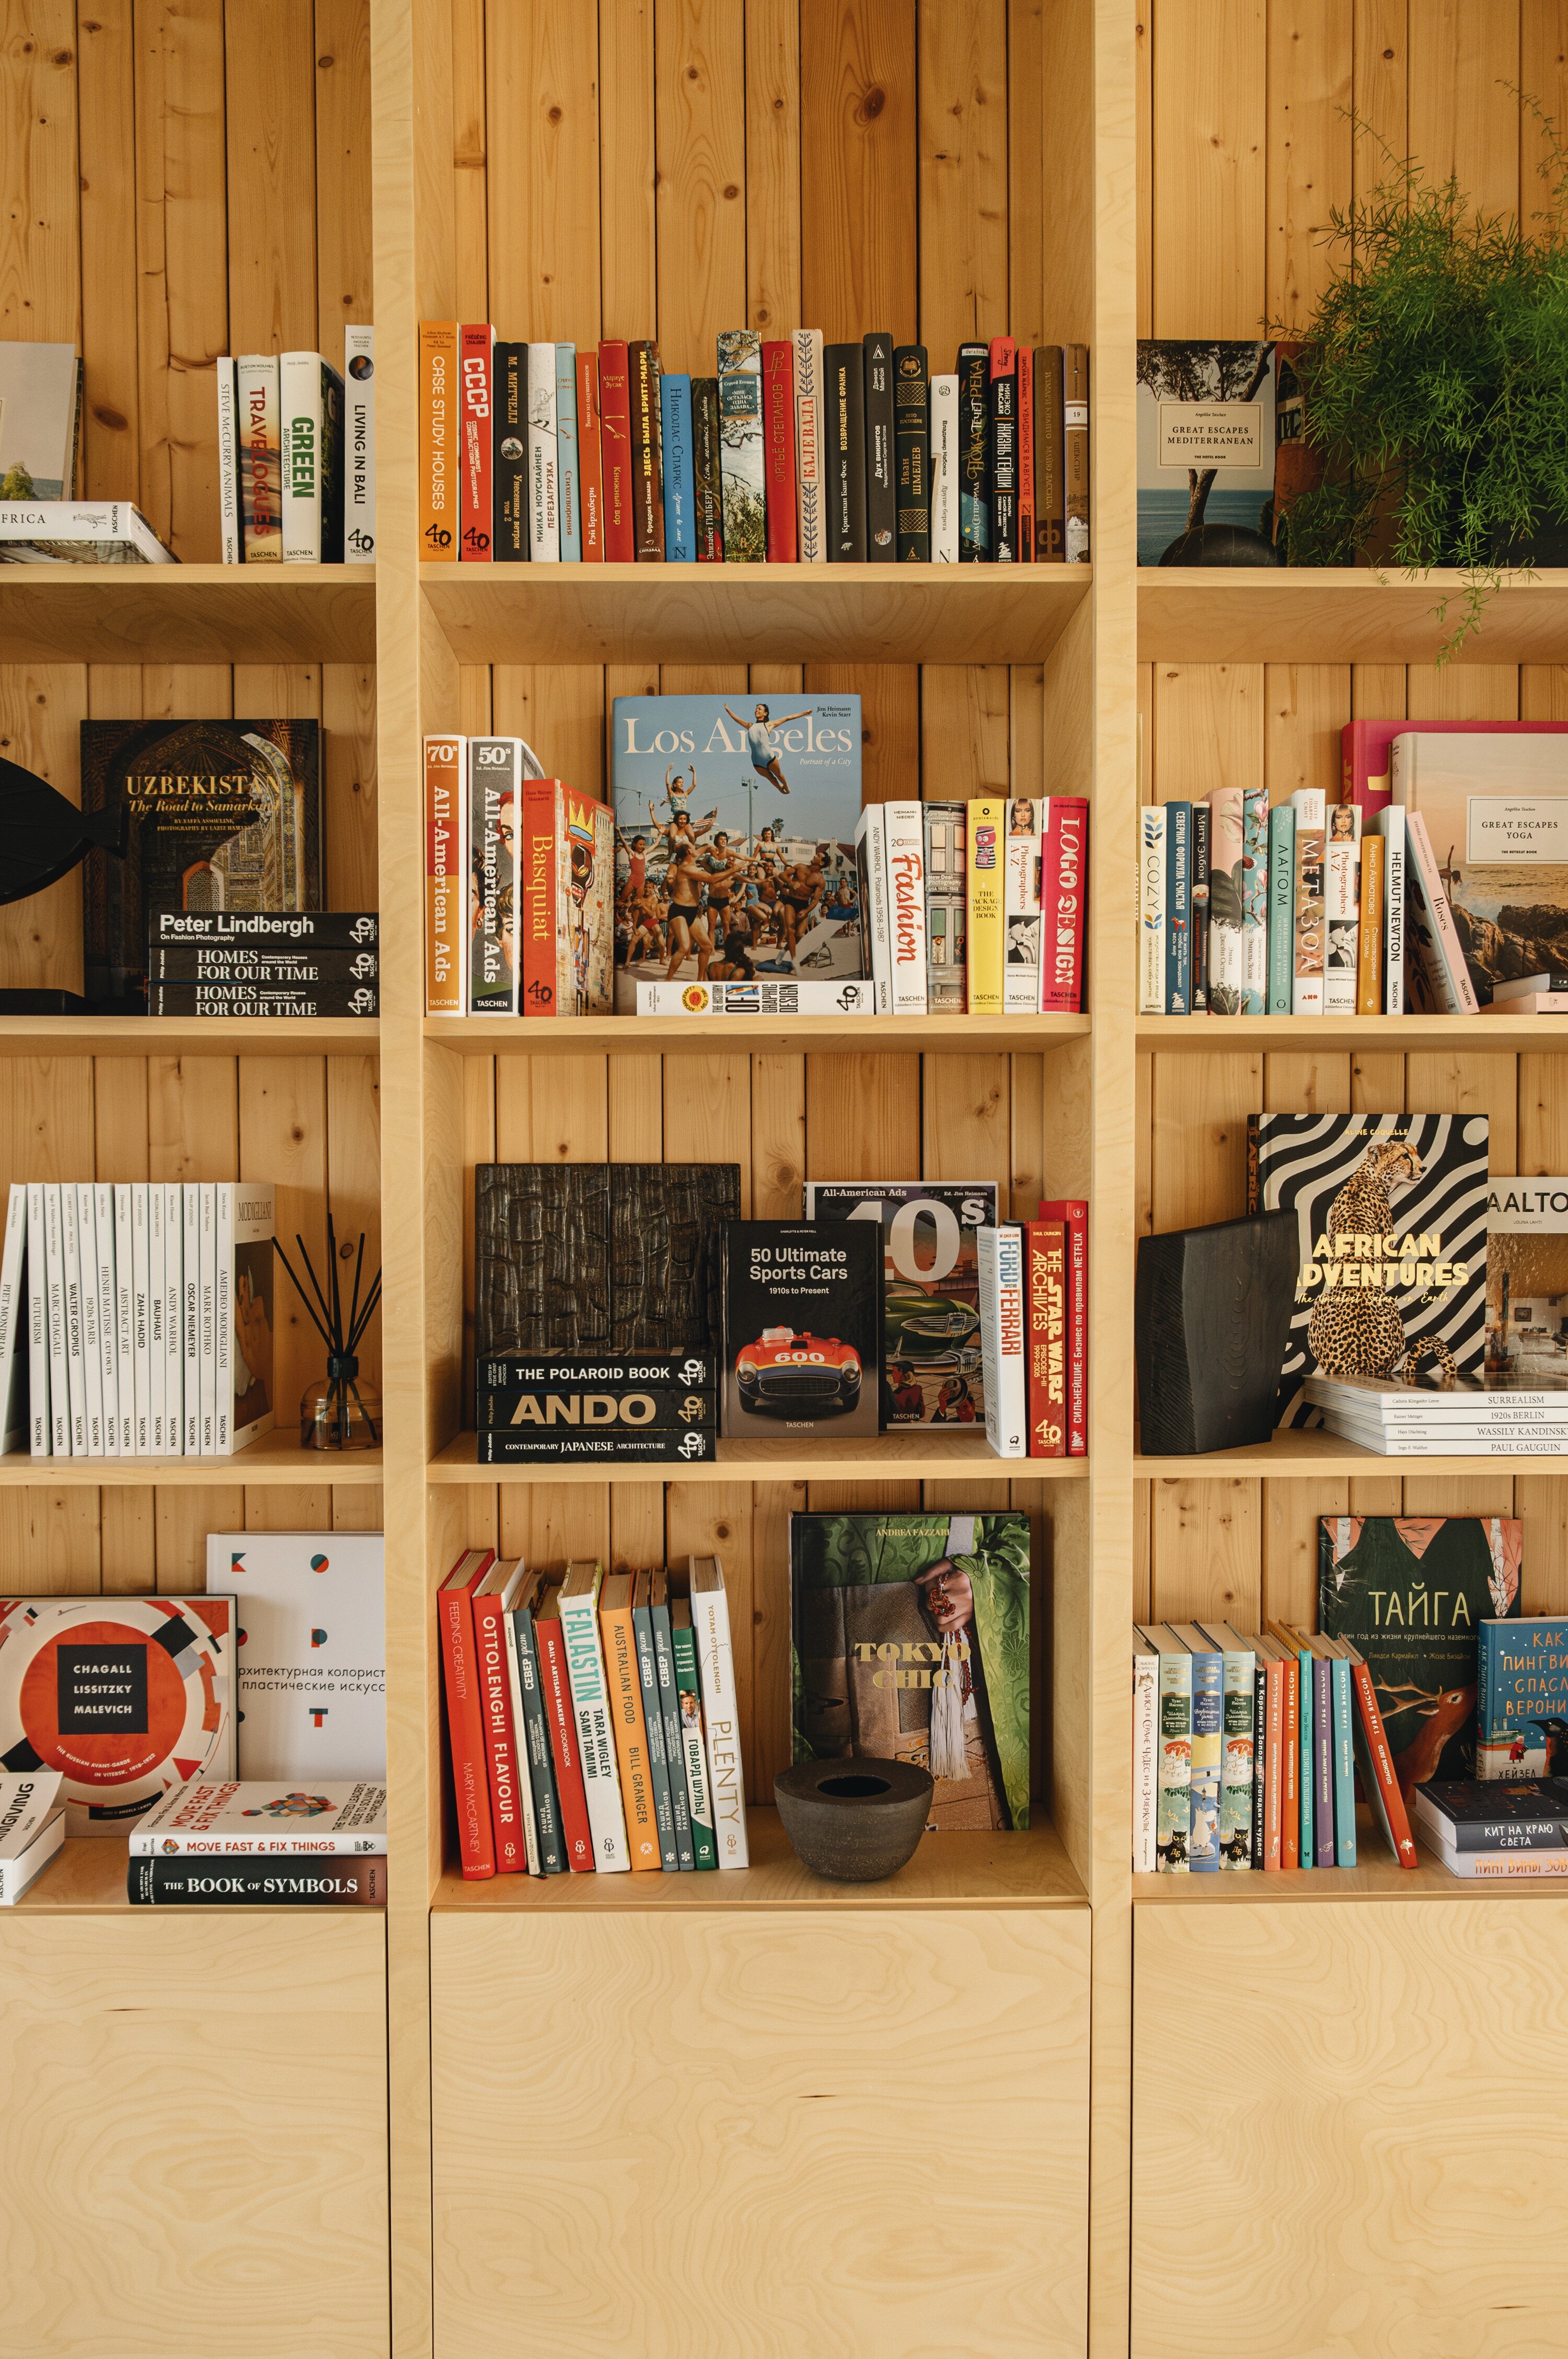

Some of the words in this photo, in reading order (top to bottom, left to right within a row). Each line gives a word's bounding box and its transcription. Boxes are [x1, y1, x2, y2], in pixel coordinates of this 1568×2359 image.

[433, 356, 445, 395] CASE
[640, 351, 649, 413] БРИТТ-МАРИ
[221, 384, 229, 412] STEVE
[355, 406, 365, 451] LIVING
[433, 399, 445, 446] STUDY
[803, 399, 815, 478] КАЛЕВАЛА
[998, 423, 1014, 455] ЖИЗНЬ
[222, 417, 230, 468] McCURRY
[292, 418, 314, 498] GREEN
[249, 387, 269, 535] TRAVELOGUES
[355, 457, 365, 470] IN
[901, 458, 909, 485] Иван
[913, 447, 921, 495] ШМЕЛЕВ
[995, 458, 1014, 487] ГЕЙШИ
[224, 470, 232, 517] ANIMALS
[354, 476, 365, 504] BALI
[432, 452, 445, 510] HOUSES
[624, 719, 695, 754] Los
[126, 776, 280, 796] UZBEKISTAN
[129, 800, 153, 811] The
[156, 800, 188, 811] Road
[191, 802, 203, 811] to
[206, 800, 280, 811] Samarkand
[1176, 812, 1185, 844] СЕВЕРНАЯ
[435, 786, 451, 933] All-American
[484, 788, 501, 934] All-American
[1059, 818, 1079, 889] LOGO
[1176, 847, 1185, 877] ФОРМУЛА
[526, 835, 553, 941] Basquiat
[1147, 856, 1159, 910] COZY
[1277, 845, 1288, 905] ЛАГОМ
[1392, 853, 1401, 903] HELMUT
[892, 853, 922, 966] Fashion
[1176, 880, 1185, 910] СЧАСТЬЯ
[1301, 840, 1319, 970] МЕТАЗОА
[160, 915, 212, 931] Peter
[218, 916, 314, 937] Lindbergh
[1433, 897, 1447, 930] Roses
[1055, 895, 1077, 985] DESIGN
[1391, 908, 1400, 961] NEWTON
[198, 950, 258, 964] HOMES
[198, 966, 230, 980] FOR
[234, 967, 270, 980] OUR
[276, 967, 318, 980] TIME
[435, 941, 451, 982] Ads
[485, 941, 500, 982] Ads
[1486, 1192, 1568, 1213] AALTO
[751, 1248, 771, 1262] 50
[776, 1248, 846, 1262] Ultimate
[999, 1241, 1020, 1282] FORD
[1047, 1249, 1062, 1272] THE
[1074, 1233, 1082, 1268] NETFLIX
[1312, 1234, 1440, 1257] AFRICAN
[750, 1266, 805, 1283] Sports
[810, 1266, 847, 1280] Cars
[1033, 1250, 1047, 1330] ARCHIVES
[1075, 1271, 1084, 1312] правилам
[1000, 1290, 1021, 1355] FERRARI
[1048, 1276, 1063, 1340] STAR
[1075, 1315, 1082, 1324] по
[71, 1318, 79, 1356] GROPIUS
[1074, 1327, 1082, 1358] Бизнес
[516, 1370, 544, 1379] THE
[550, 1368, 623, 1379] POLAROID
[629, 1367, 670, 1378] BOOK
[775, 1352, 825, 1363] 600
[1048, 1342, 1063, 1404] WARS
[510, 1395, 656, 1424] ANDO
[1073, 1361, 1082, 1423] СИЛЬНЕЙШИЕ.
[560, 1442, 613, 1453] JAPANESE
[1368, 1582, 1471, 1626] ТАЙГА
[74, 1665, 132, 1674] CHAGALL
[565, 1609, 601, 1702] FALASTIN
[614, 1626, 631, 1691] AUSTRALIAN
[855, 1643, 971, 1662] TOKYO
[74, 1685, 132, 1694] LISSITZKY
[873, 1670, 953, 1688] CHIC
[74, 1705, 132, 1713] MALEVICH
[483, 1617, 505, 1733] OTTOLENGHI
[494, 1743, 513, 1824] FLAVOUR
[622, 1695, 635, 1723] FOOD
[629, 1747, 641, 1770] BILL
[688, 1740, 700, 1776] ГОВАРД
[712, 1721, 740, 1824] PLENTY
[631, 1774, 647, 1824] GRANGER
[693, 1778, 705, 1815] ШУЛЬЦ
[187, 1843, 222, 1851] MOVE
[226, 1843, 253, 1851] FAST
[270, 1843, 286, 1851] FIX
[291, 1842, 335, 1851] THINGS
[1485, 1826, 1505, 1836] КИТ
[1509, 1826, 1522, 1835] НА
[1526, 1824, 1553, 1834] КРАЮ
[1501, 1837, 1531, 1846] СВЕТА
[187, 1879, 244, 1893] BOOK
[264, 1879, 358, 1893] SYMBOLS
